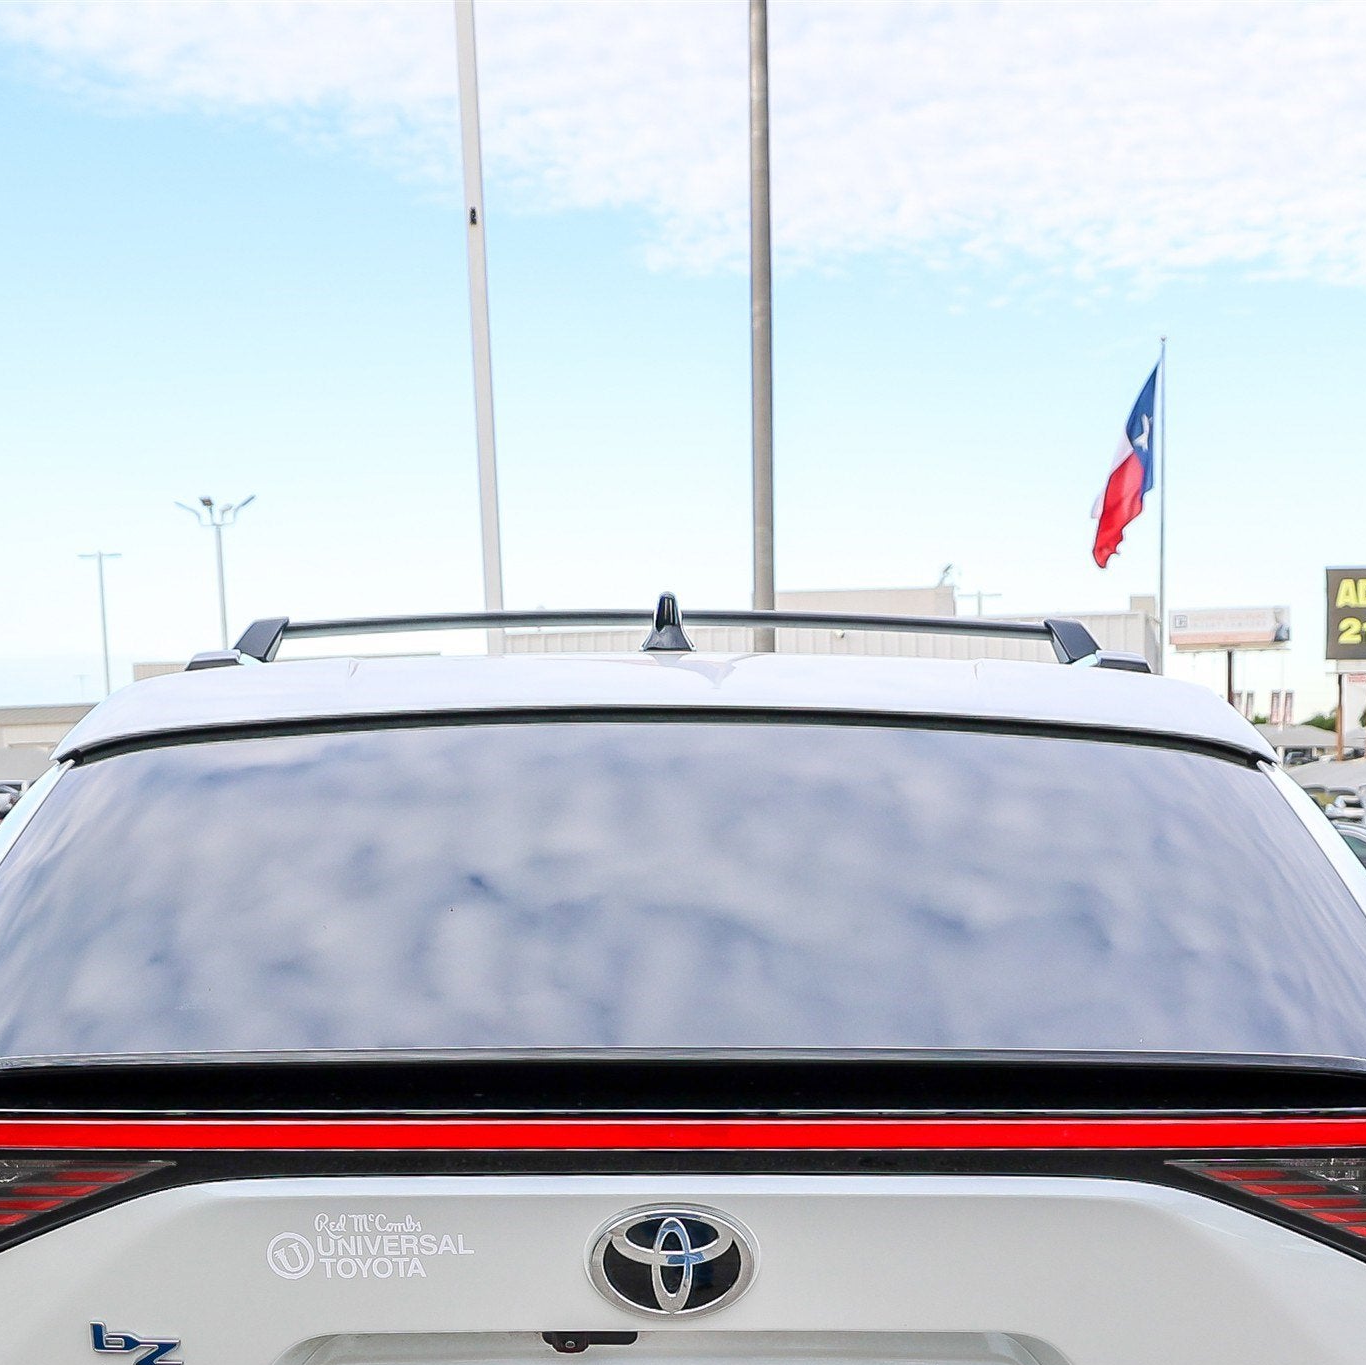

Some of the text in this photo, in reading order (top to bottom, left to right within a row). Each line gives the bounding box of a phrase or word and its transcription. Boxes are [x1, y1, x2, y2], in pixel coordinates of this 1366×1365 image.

[314, 1213, 347, 1239] Red
[316, 1234, 475, 1256] UNIVERSAL
[319, 1257, 427, 1279] TOYOTA
